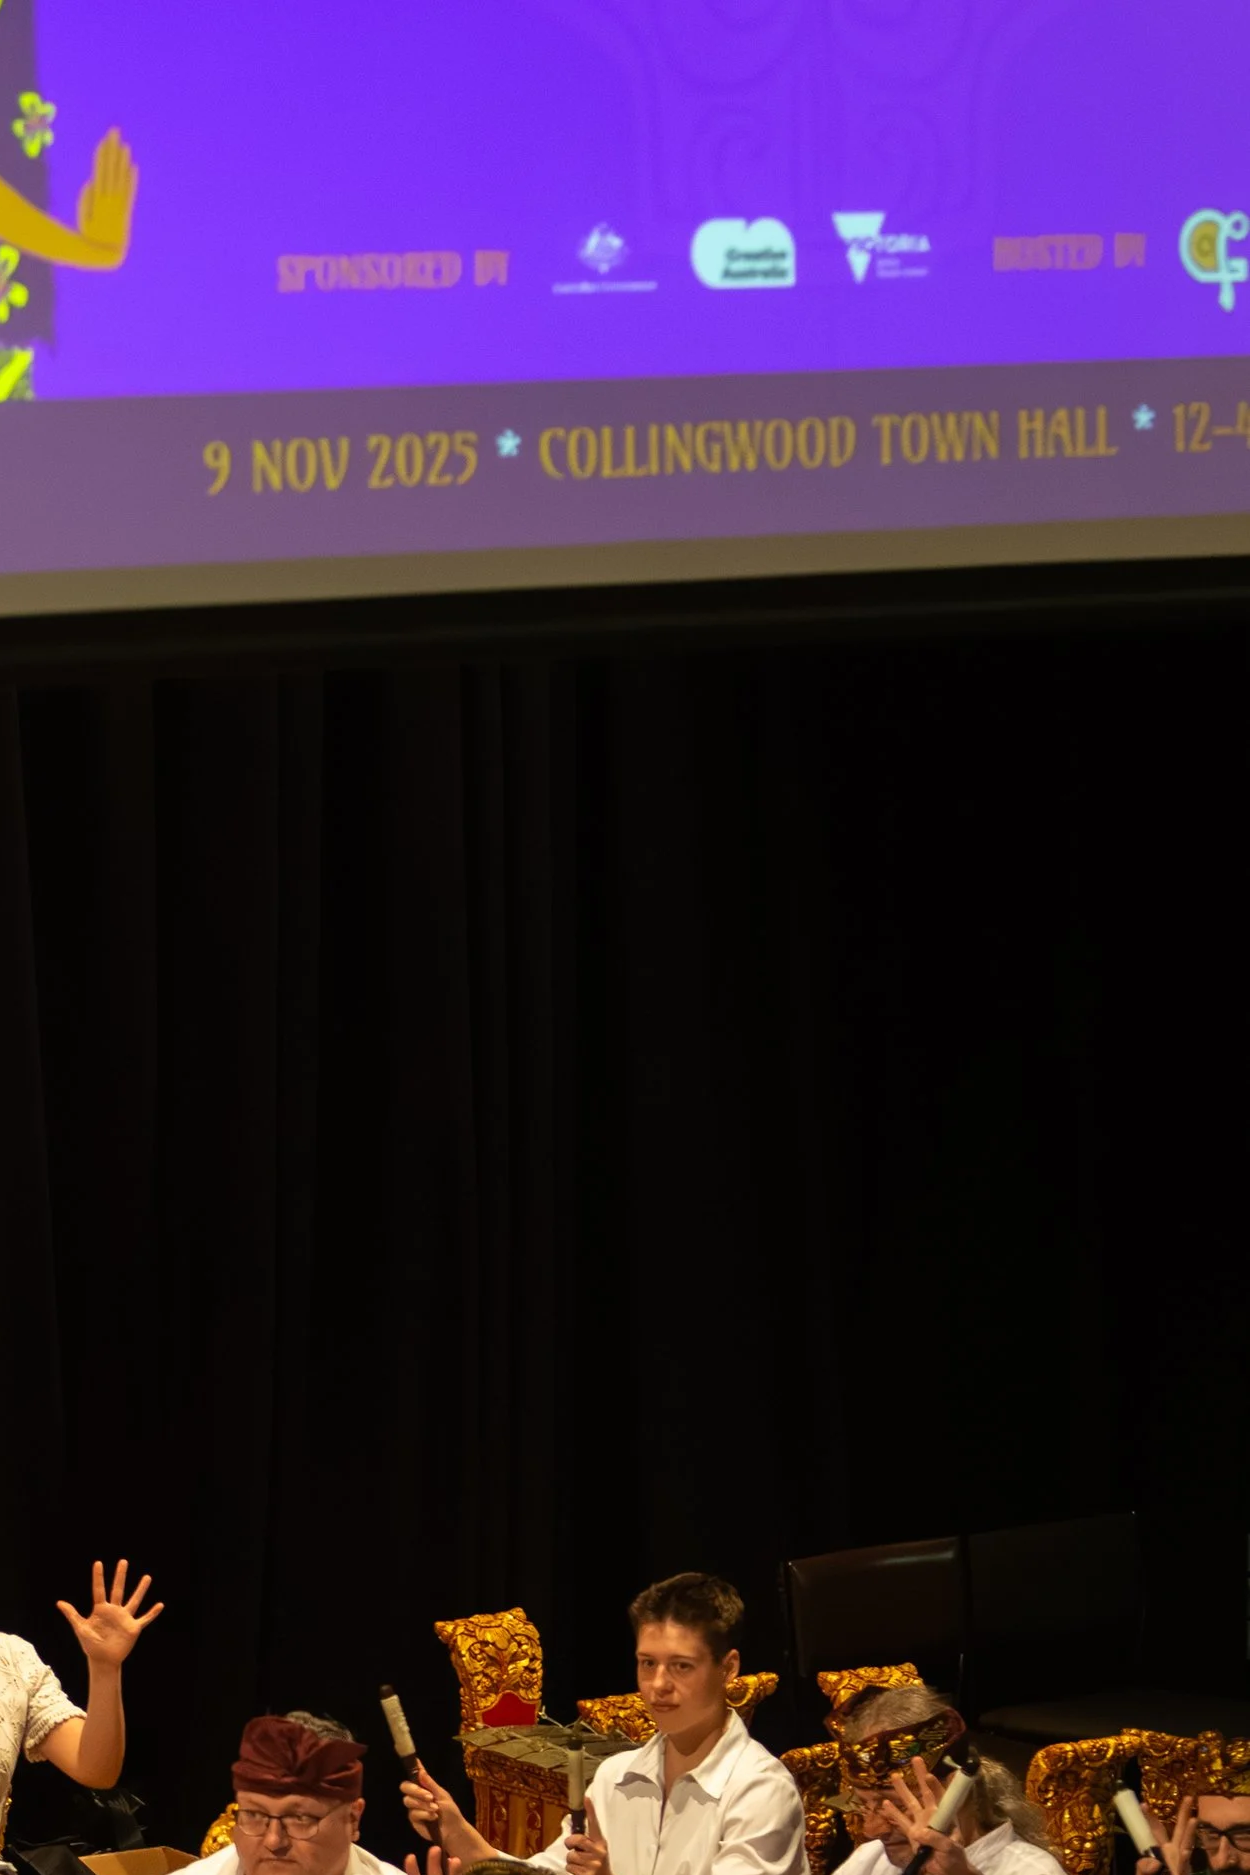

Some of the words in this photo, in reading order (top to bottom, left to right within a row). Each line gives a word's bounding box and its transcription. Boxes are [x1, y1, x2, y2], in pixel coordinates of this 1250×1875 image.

[203, 440, 231, 496] 9
[252, 436, 350, 492] NOV
[366, 430, 478, 489] 2025
[538, 416, 857, 479] COLLINGWOOD
[872, 410, 1000, 466] TOWN
[1017, 405, 1119, 459] HALL
